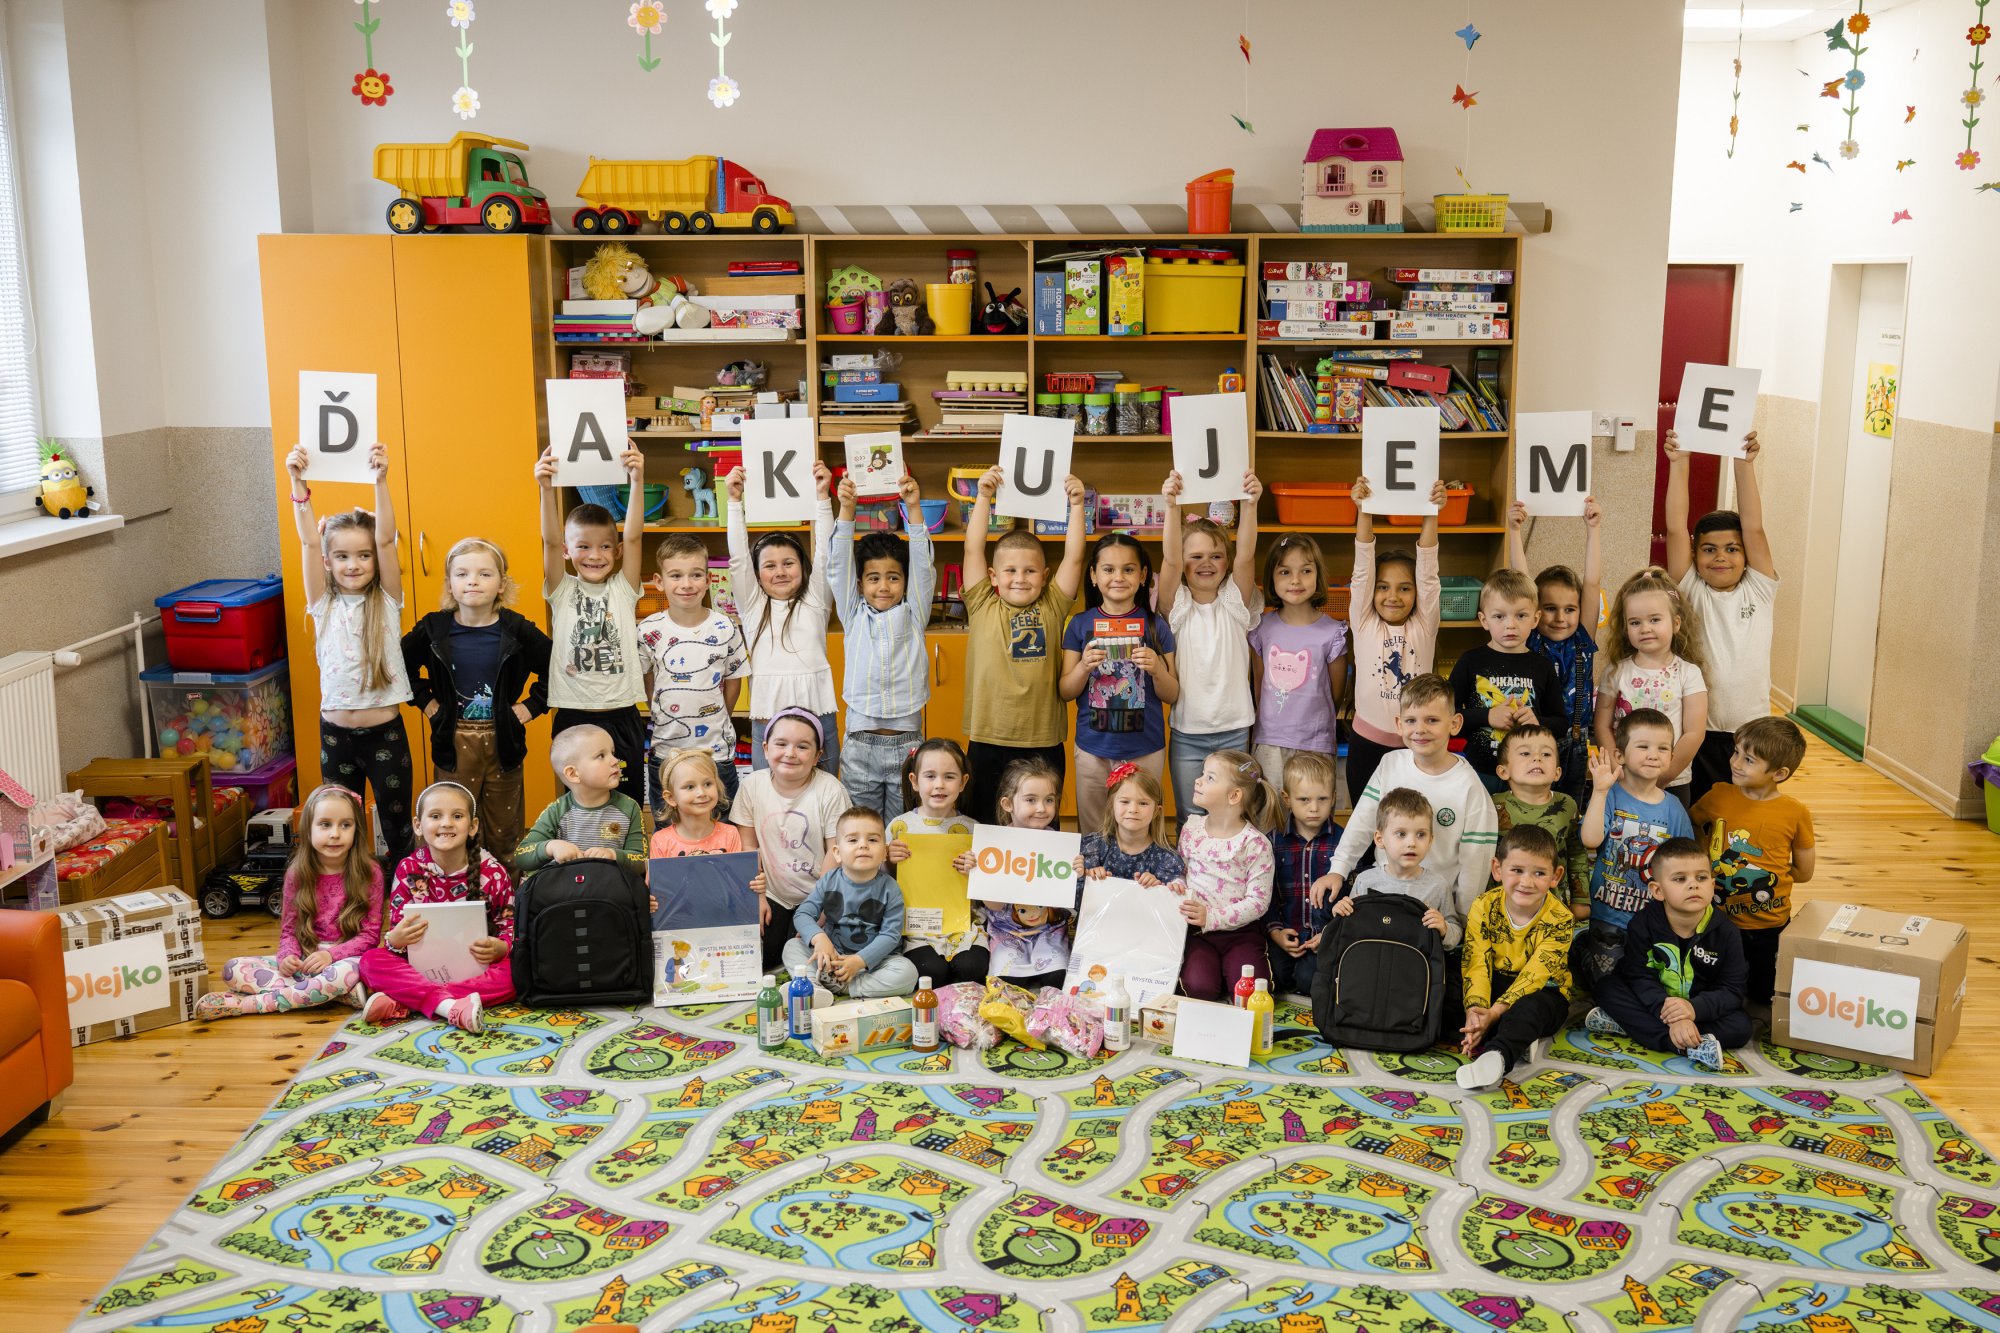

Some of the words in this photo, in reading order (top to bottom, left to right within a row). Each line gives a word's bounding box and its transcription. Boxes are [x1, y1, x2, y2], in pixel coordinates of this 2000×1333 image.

[319, 390, 359, 453] Ď
[1697, 386, 1736, 432] E
[567, 412, 613, 462] A
[1198, 427, 1220, 479] J
[763, 449, 800, 499] K
[1013, 446, 1055, 497] U
[1385, 440, 1417, 491] E
[1529, 443, 1587, 493] M
[1010, 615, 1043, 630] REBEL
[1489, 676, 1533, 689] PIKACHU
[976, 846, 1073, 883] Olejko
[1605, 880, 1654, 900] CAPTAIN
[1725, 895, 1787, 916] Wheeler
[65, 965, 162, 1004] Olejko
[1797, 986, 1908, 1030] Olejko
